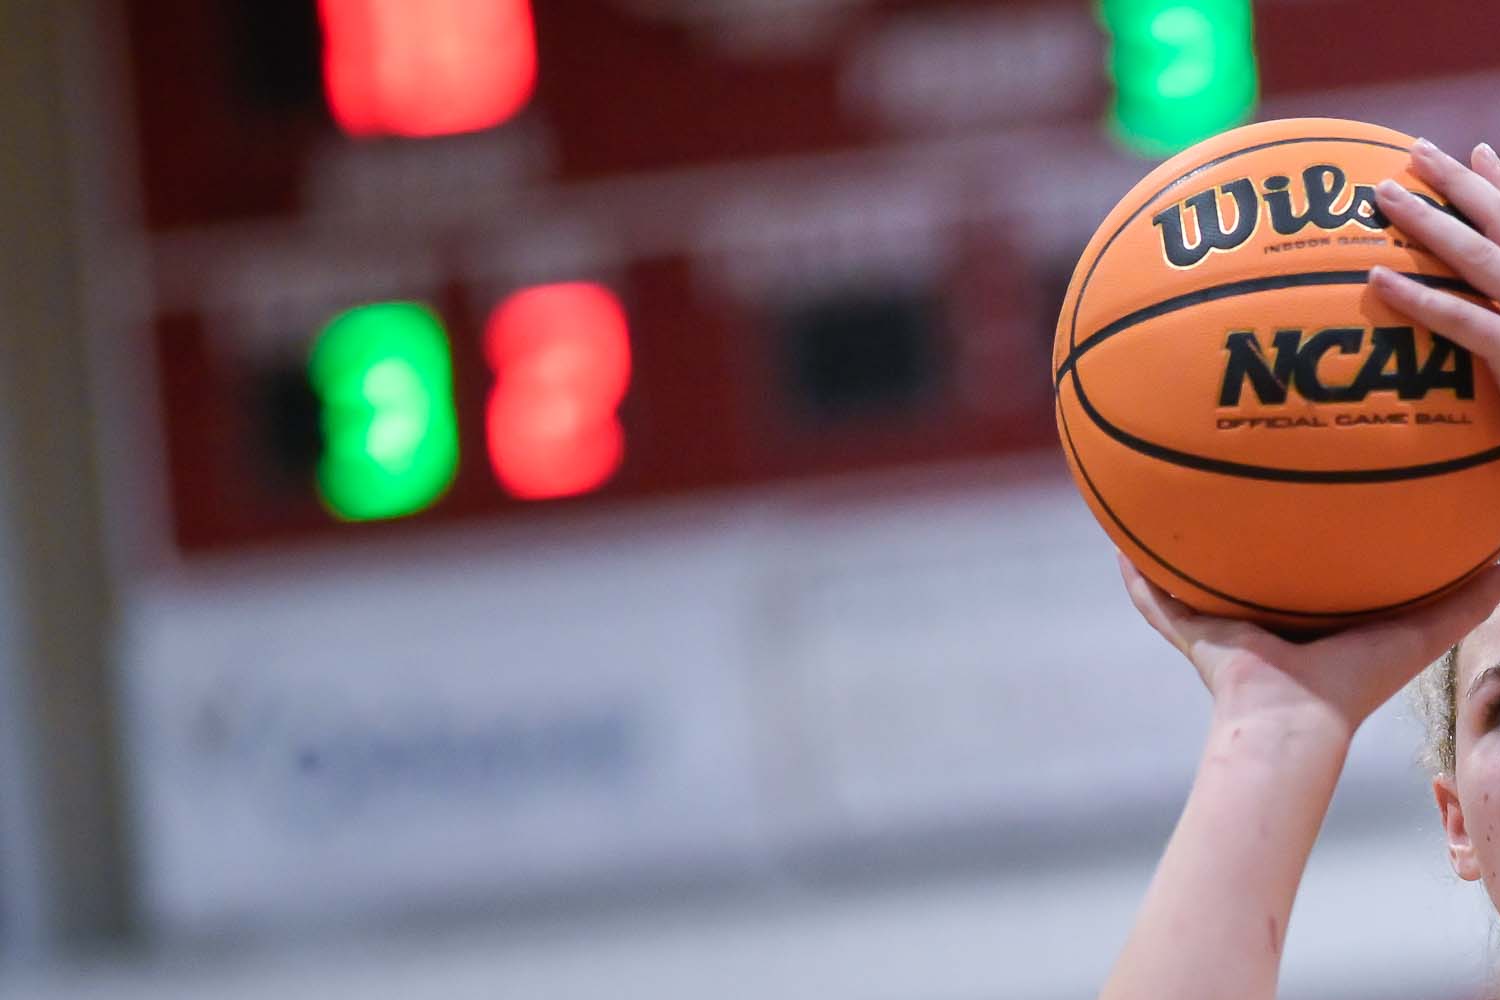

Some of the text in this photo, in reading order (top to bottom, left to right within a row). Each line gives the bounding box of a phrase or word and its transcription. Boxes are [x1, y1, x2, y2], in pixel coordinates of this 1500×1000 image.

[1152, 163, 1480, 270] Wils
[1264, 236, 1332, 255] INDOOR
[1218, 326, 1475, 407] NCAA
[1216, 412, 1473, 430] OFFICIAL GAME BALL
